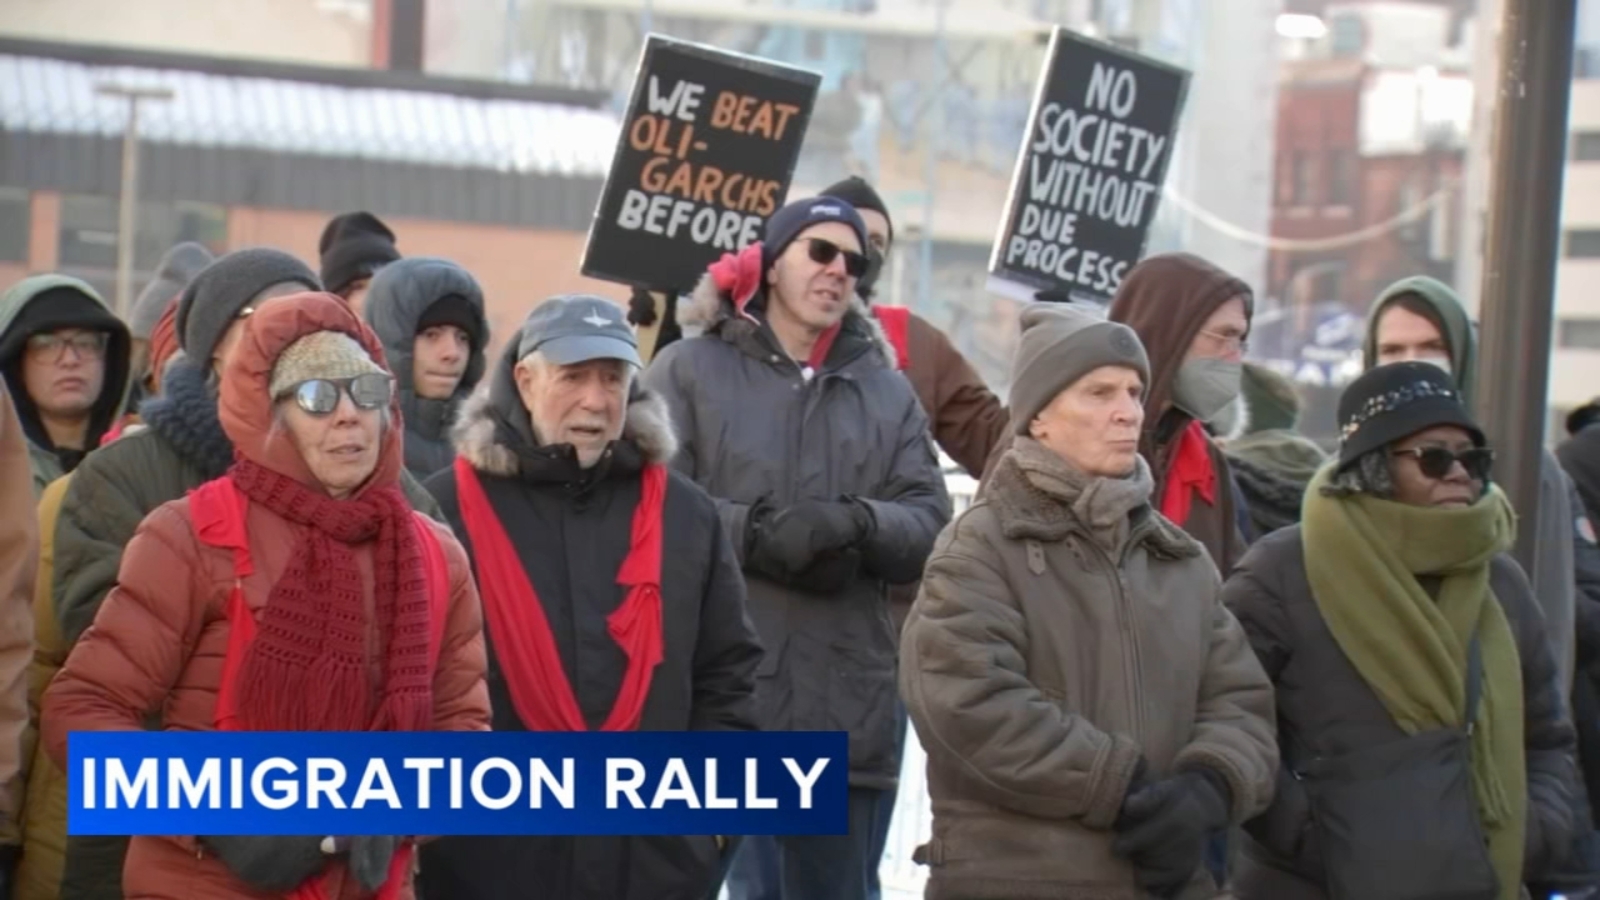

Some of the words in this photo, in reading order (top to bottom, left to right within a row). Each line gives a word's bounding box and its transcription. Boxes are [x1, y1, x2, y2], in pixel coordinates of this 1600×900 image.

[647, 75, 705, 122] WE
[710, 90, 800, 140] BEAT
[1084, 62, 1137, 118] NO
[629, 115, 708, 159] OLI-
[1033, 103, 1165, 179] SOCIETY
[640, 156, 780, 216] GARCHS
[1030, 154, 1156, 227] WITHOUT
[617, 189, 763, 251] BEFORE
[1019, 203, 1077, 245] DUE
[1006, 235, 1128, 295] PROCESS
